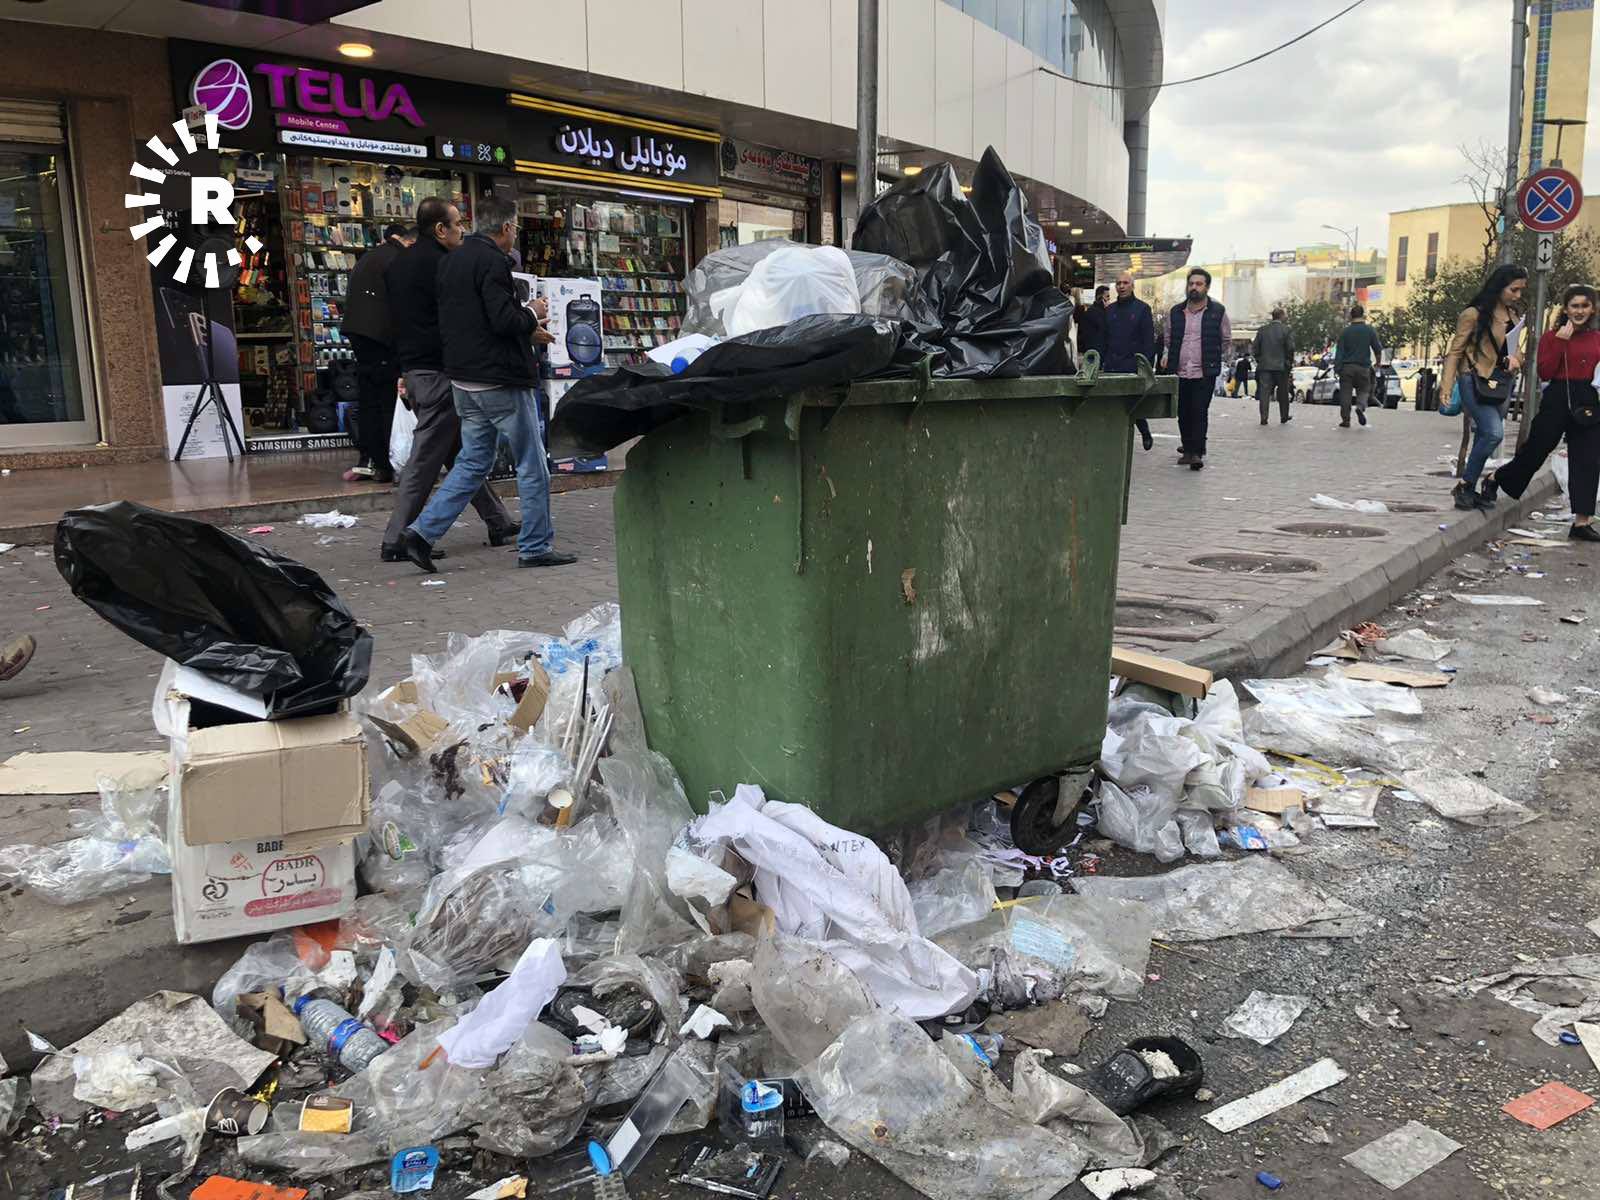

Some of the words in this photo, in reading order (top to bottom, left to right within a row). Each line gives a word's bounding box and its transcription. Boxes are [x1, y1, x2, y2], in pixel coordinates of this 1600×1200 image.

[253, 63, 427, 128] TELIA
[287, 116, 315, 128] Mobile
[315, 119, 340, 130] Center
[561, 124, 615, 166] دیلان
[250, 440, 302, 451] SAMSUNG
[275, 858, 315, 872] BADR
